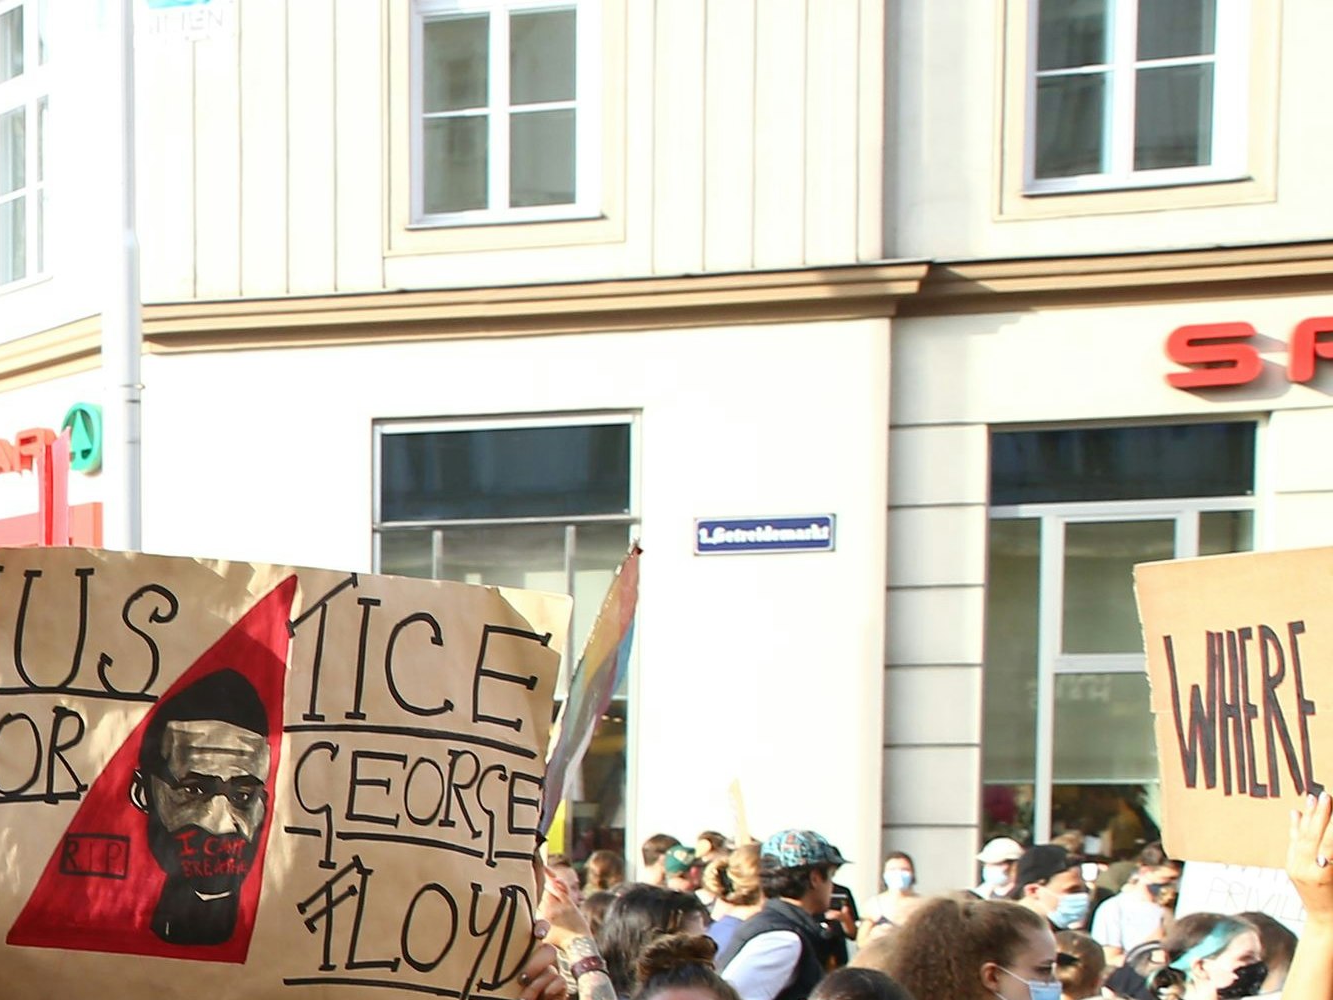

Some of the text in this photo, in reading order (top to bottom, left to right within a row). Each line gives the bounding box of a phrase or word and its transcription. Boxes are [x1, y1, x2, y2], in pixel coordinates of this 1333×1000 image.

[284, 572, 552, 731] TICE
[1162, 620, 1324, 799] WHERE
[293, 740, 546, 869] GEORGE
